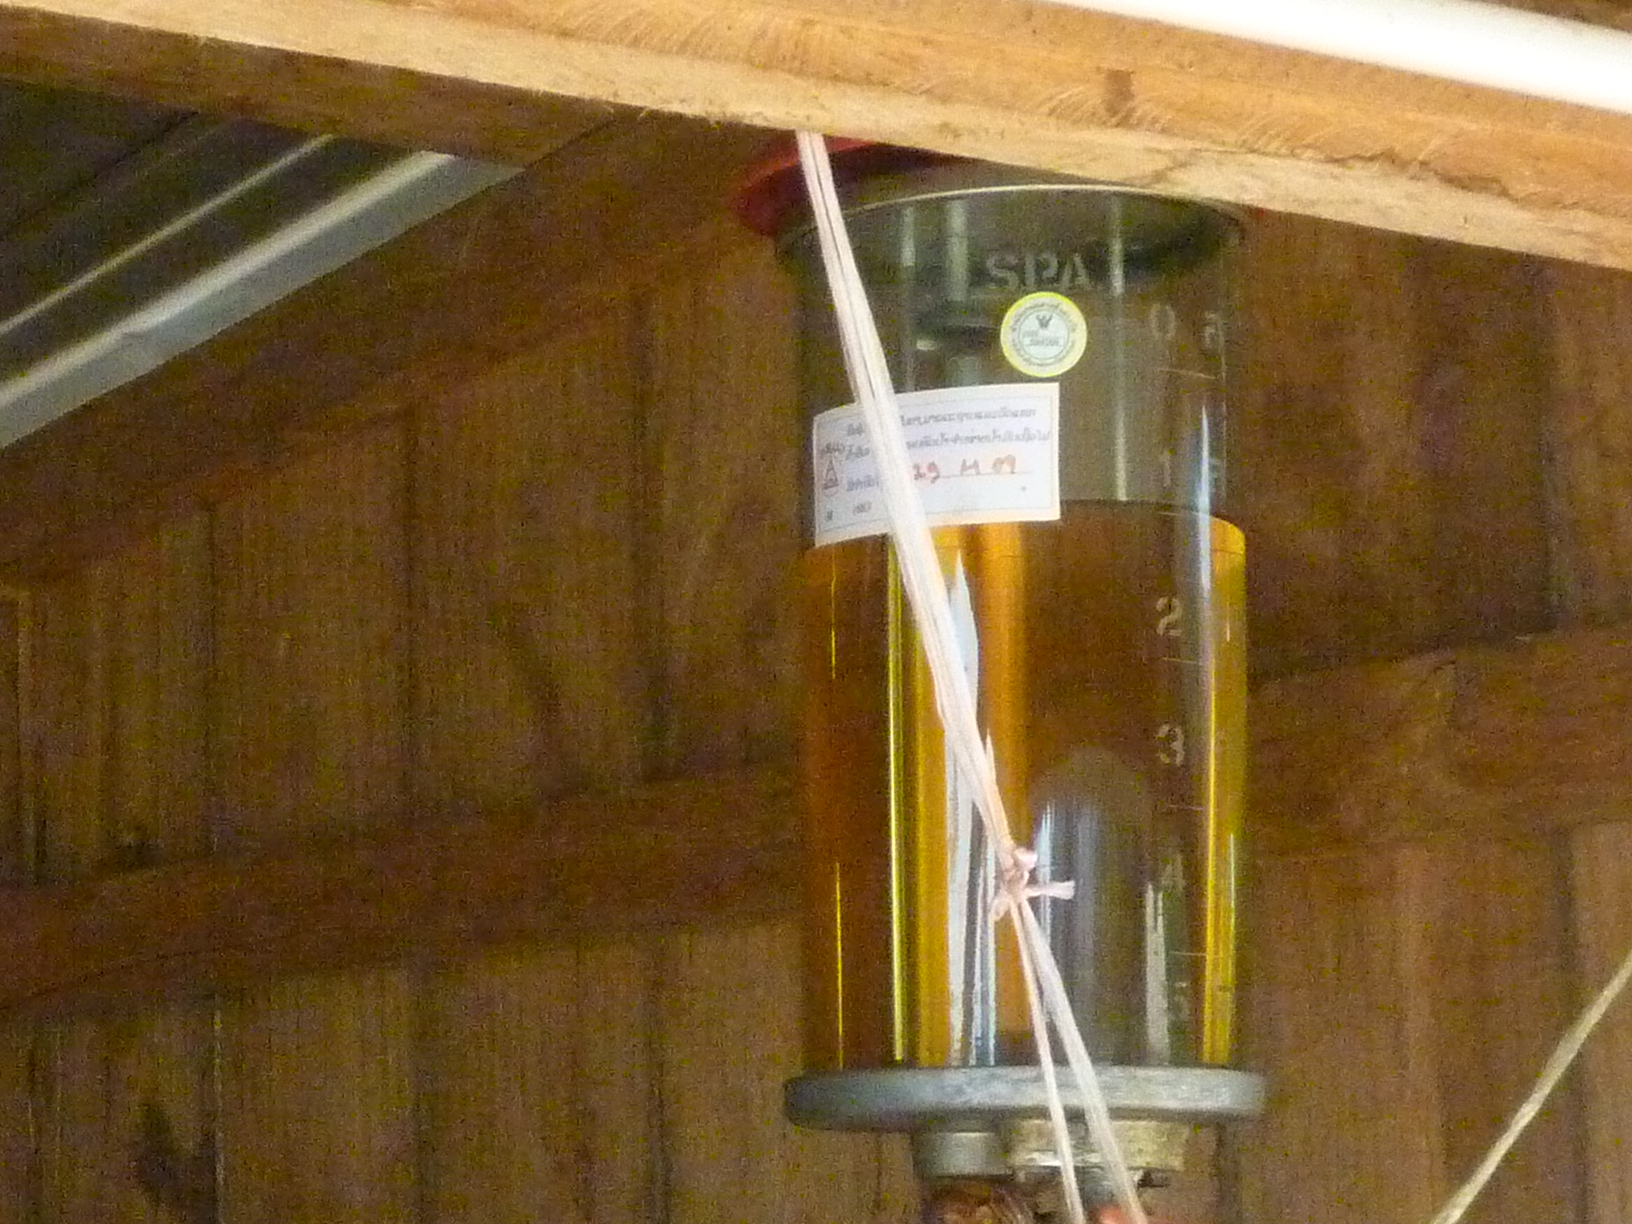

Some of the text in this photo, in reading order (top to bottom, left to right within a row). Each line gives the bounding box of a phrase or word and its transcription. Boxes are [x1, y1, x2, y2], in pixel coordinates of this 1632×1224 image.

[986, 252, 1091, 292] SPA
[1156, 597, 1182, 637] 2
[1156, 723, 1185, 766] 3
